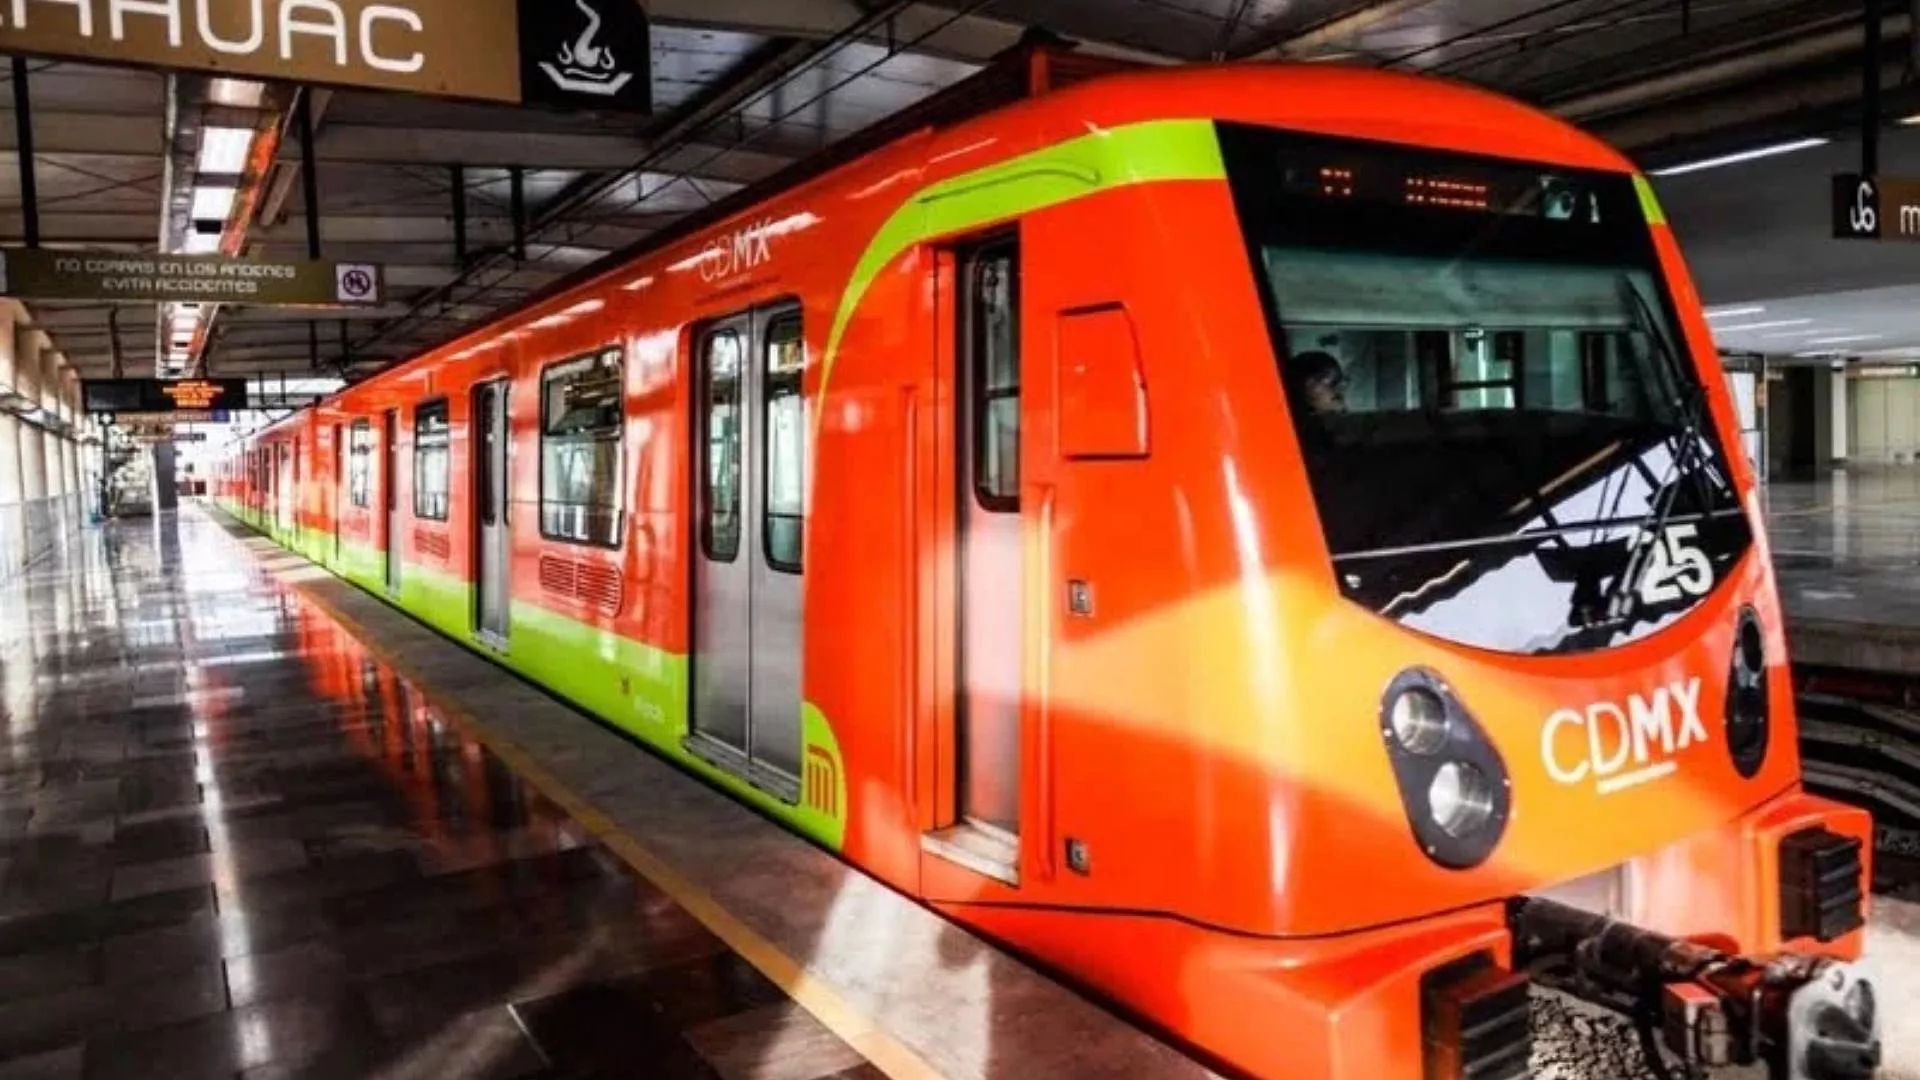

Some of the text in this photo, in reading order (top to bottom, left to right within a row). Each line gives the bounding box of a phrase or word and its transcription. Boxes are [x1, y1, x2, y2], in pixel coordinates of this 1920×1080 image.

[0, 0, 424, 73] HUAC
[56, 258, 80, 272] NO
[85, 259, 154, 274] CORRAS
[159, 261, 182, 275] EN
[187, 262, 217, 276] LOS
[102, 276, 257, 293] EVITA ACCIDENTES
[1541, 676, 1709, 785] CDMX
